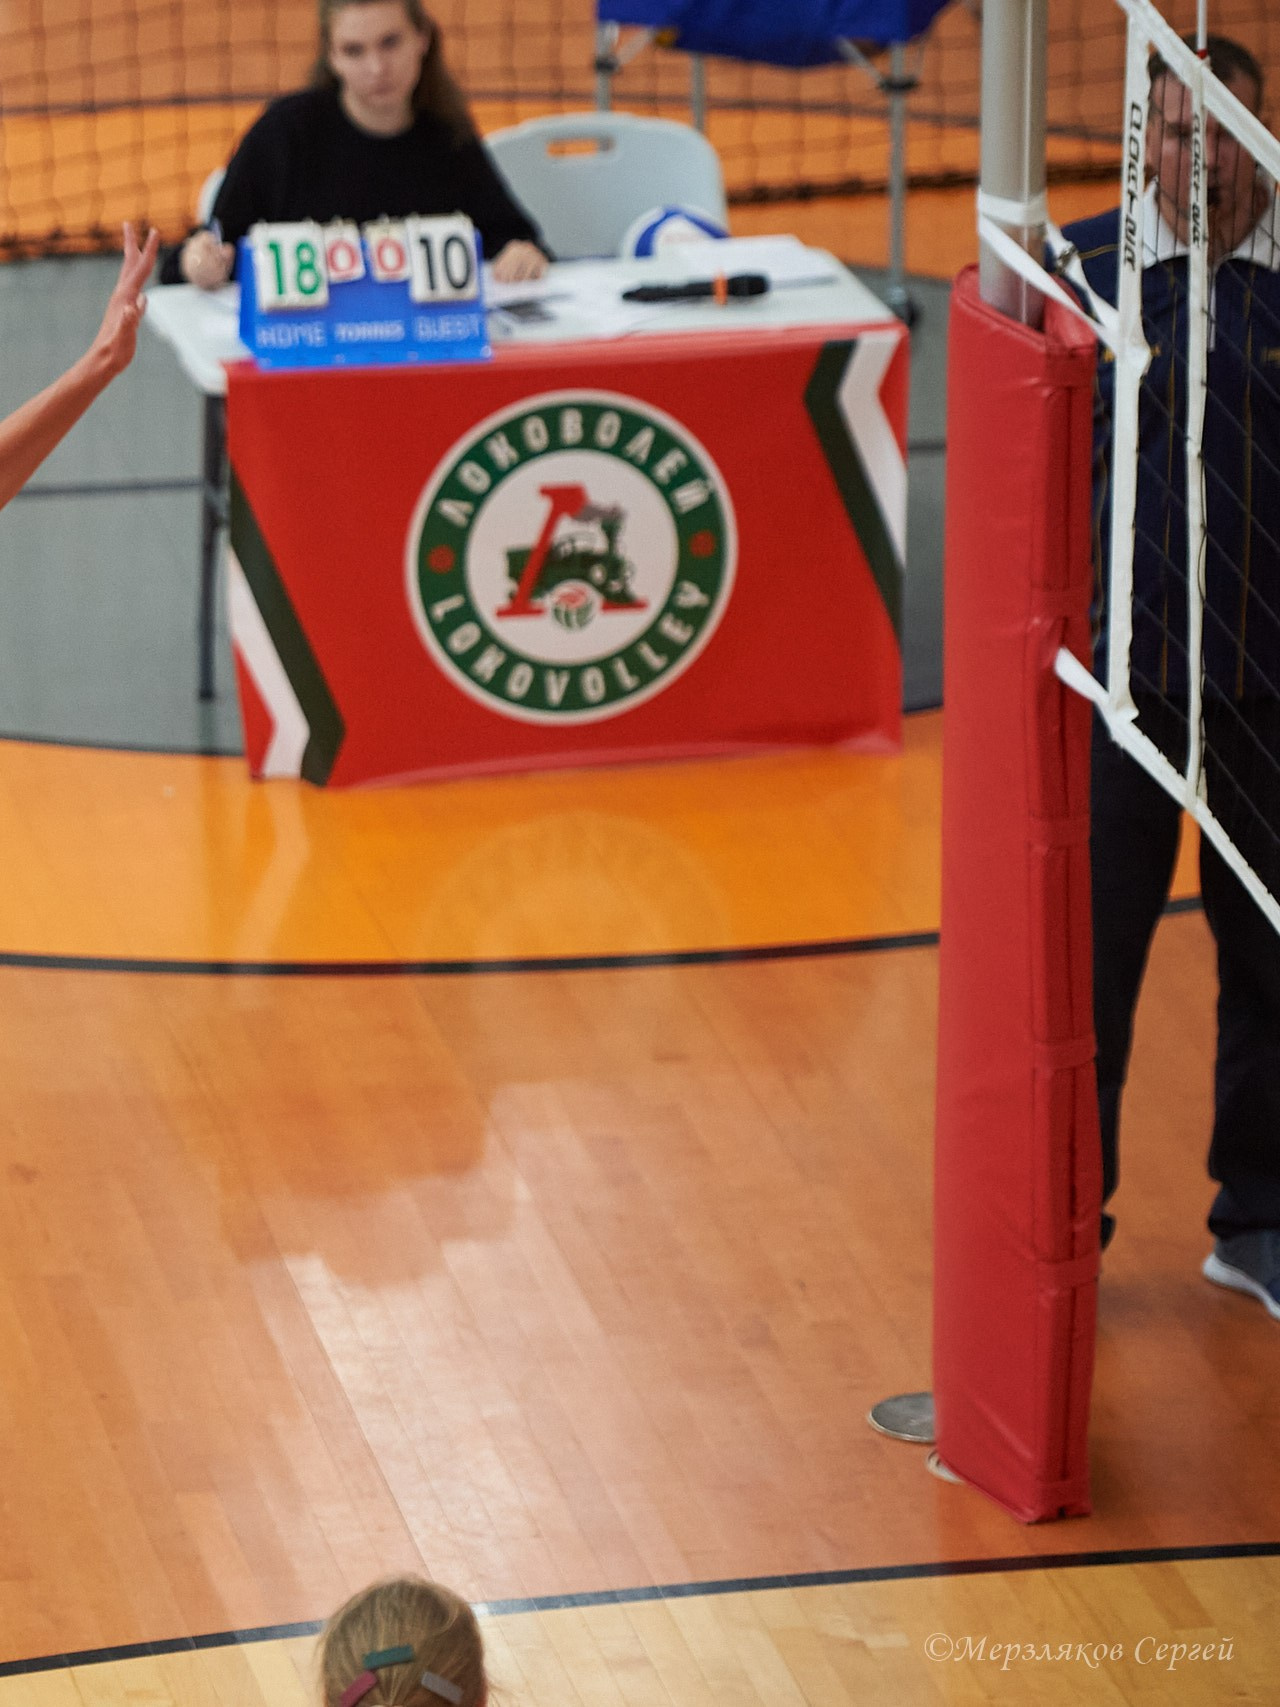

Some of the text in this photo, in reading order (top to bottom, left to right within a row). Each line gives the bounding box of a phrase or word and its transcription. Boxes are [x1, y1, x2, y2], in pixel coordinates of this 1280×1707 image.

[269, 236, 470, 295] 18 0 0 10
[257, 323, 326, 347] HOME
[413, 314, 480, 341] GUEST
[431, 580, 710, 706] LOKOVOLLEY
